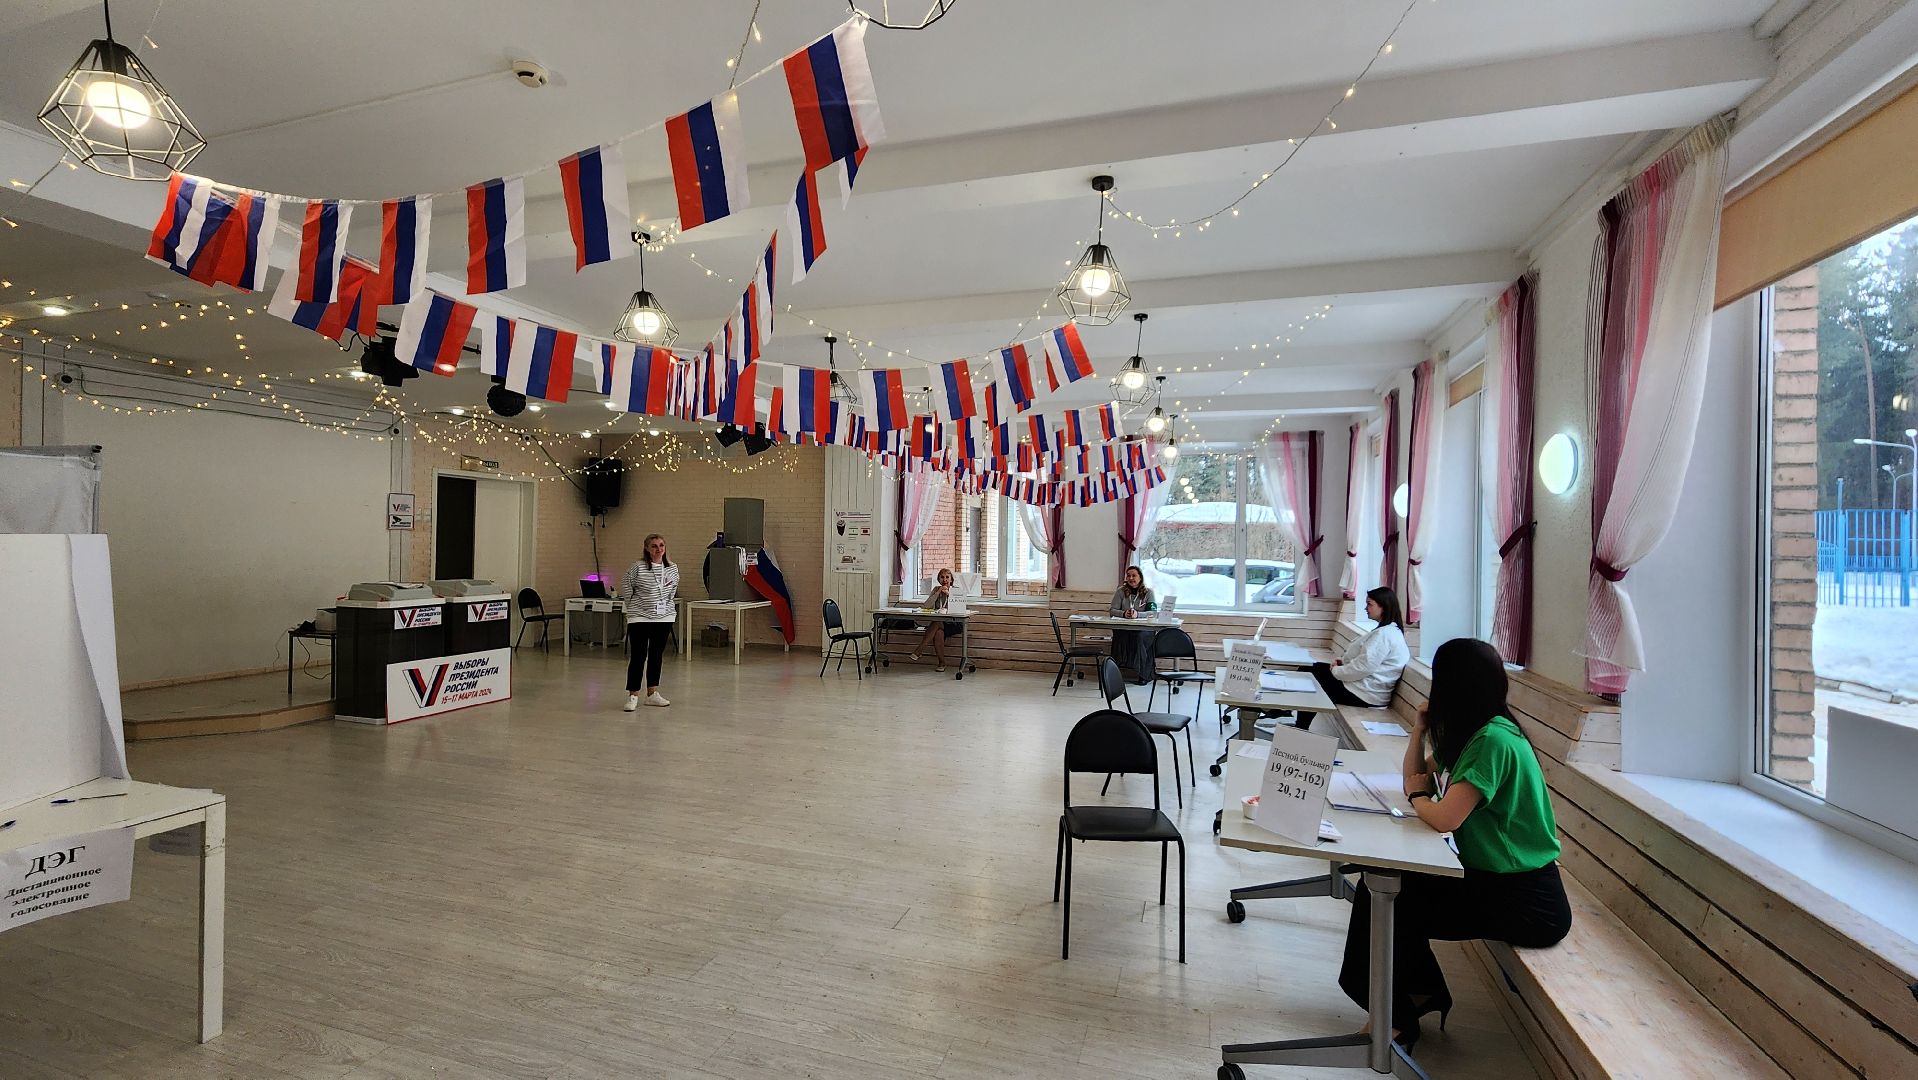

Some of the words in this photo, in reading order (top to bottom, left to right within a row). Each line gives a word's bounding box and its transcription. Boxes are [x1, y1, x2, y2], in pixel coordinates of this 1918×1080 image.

[448, 666, 499, 682] ПРЕЗИДЕНТА
[453, 657, 490, 671] ВЫБОРЫ
[444, 680, 478, 694] РОССИИ
[458, 690, 478, 702] МАРТА
[478, 688, 492, 697] 2024
[1272, 748, 1299, 762] Лесной
[1299, 755, 1331, 772] бульвар
[1270, 762, 1282, 773] 19
[1283, 766, 1325, 788] (97-162)
[1277, 782, 1292, 797] 20,
[1294, 788, 1307, 800] 21
[24, 846, 86, 880] ДЭГ
[4, 868, 102, 900] Дистанционное
[12, 881, 91, 906] электронное
[10, 892, 90, 918] голосование
